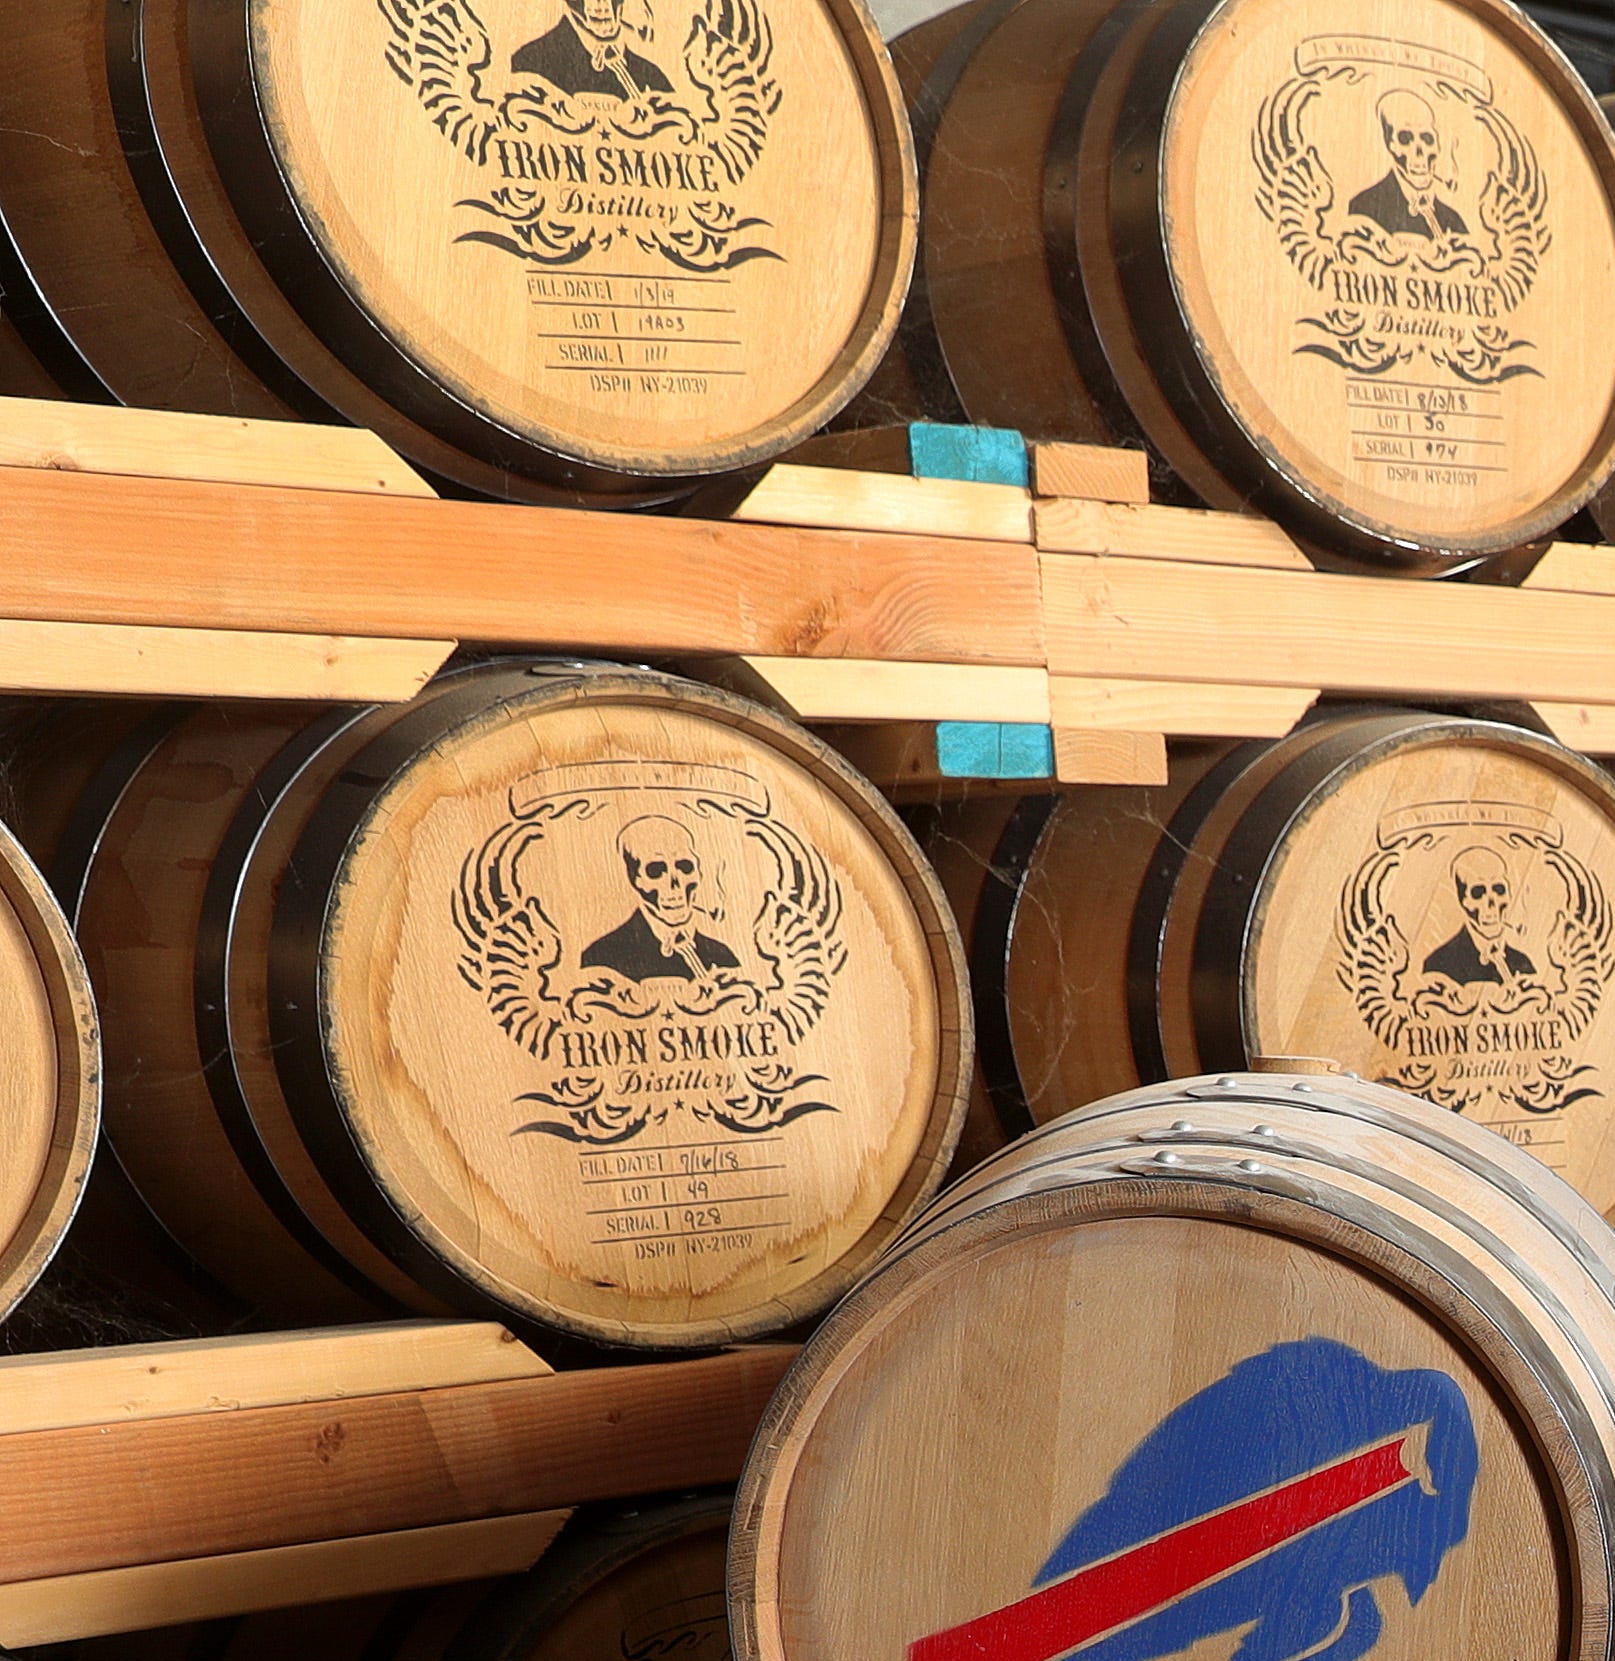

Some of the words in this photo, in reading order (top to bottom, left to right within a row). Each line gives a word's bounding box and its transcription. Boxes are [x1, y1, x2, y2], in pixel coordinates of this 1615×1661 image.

[495, 139, 588, 183] IRON
[595, 146, 719, 192] SMOKE
[557, 187, 678, 227] Distillery
[527, 279, 561, 297] FILL
[564, 280, 606, 299] DATE
[1331, 269, 1398, 307] IRON
[1405, 277, 1497, 318] SMOKE
[573, 312, 602, 329] LOT
[1374, 311, 1466, 345] Distillery
[559, 343, 613, 362] SERIAL
[1377, 413, 1400, 429] LOT
[1366, 440, 1406, 456] SERIAL
[559, 1028, 648, 1069] IRON
[658, 1021, 779, 1063] SMOKE
[1406, 1024, 1468, 1057] IRON
[1476, 1020, 1562, 1053] SMOKE
[1448, 1056, 1532, 1081] Distillery
[615, 1069, 736, 1095] Distillery
[579, 1160, 612, 1177] FILL
[616, 1156, 654, 1173] DATE
[622, 1184, 651, 1203] LOT
[688, 1181, 709, 1199] 49
[607, 1213, 659, 1234] SERIAL
[684, 1208, 721, 1230] 928
